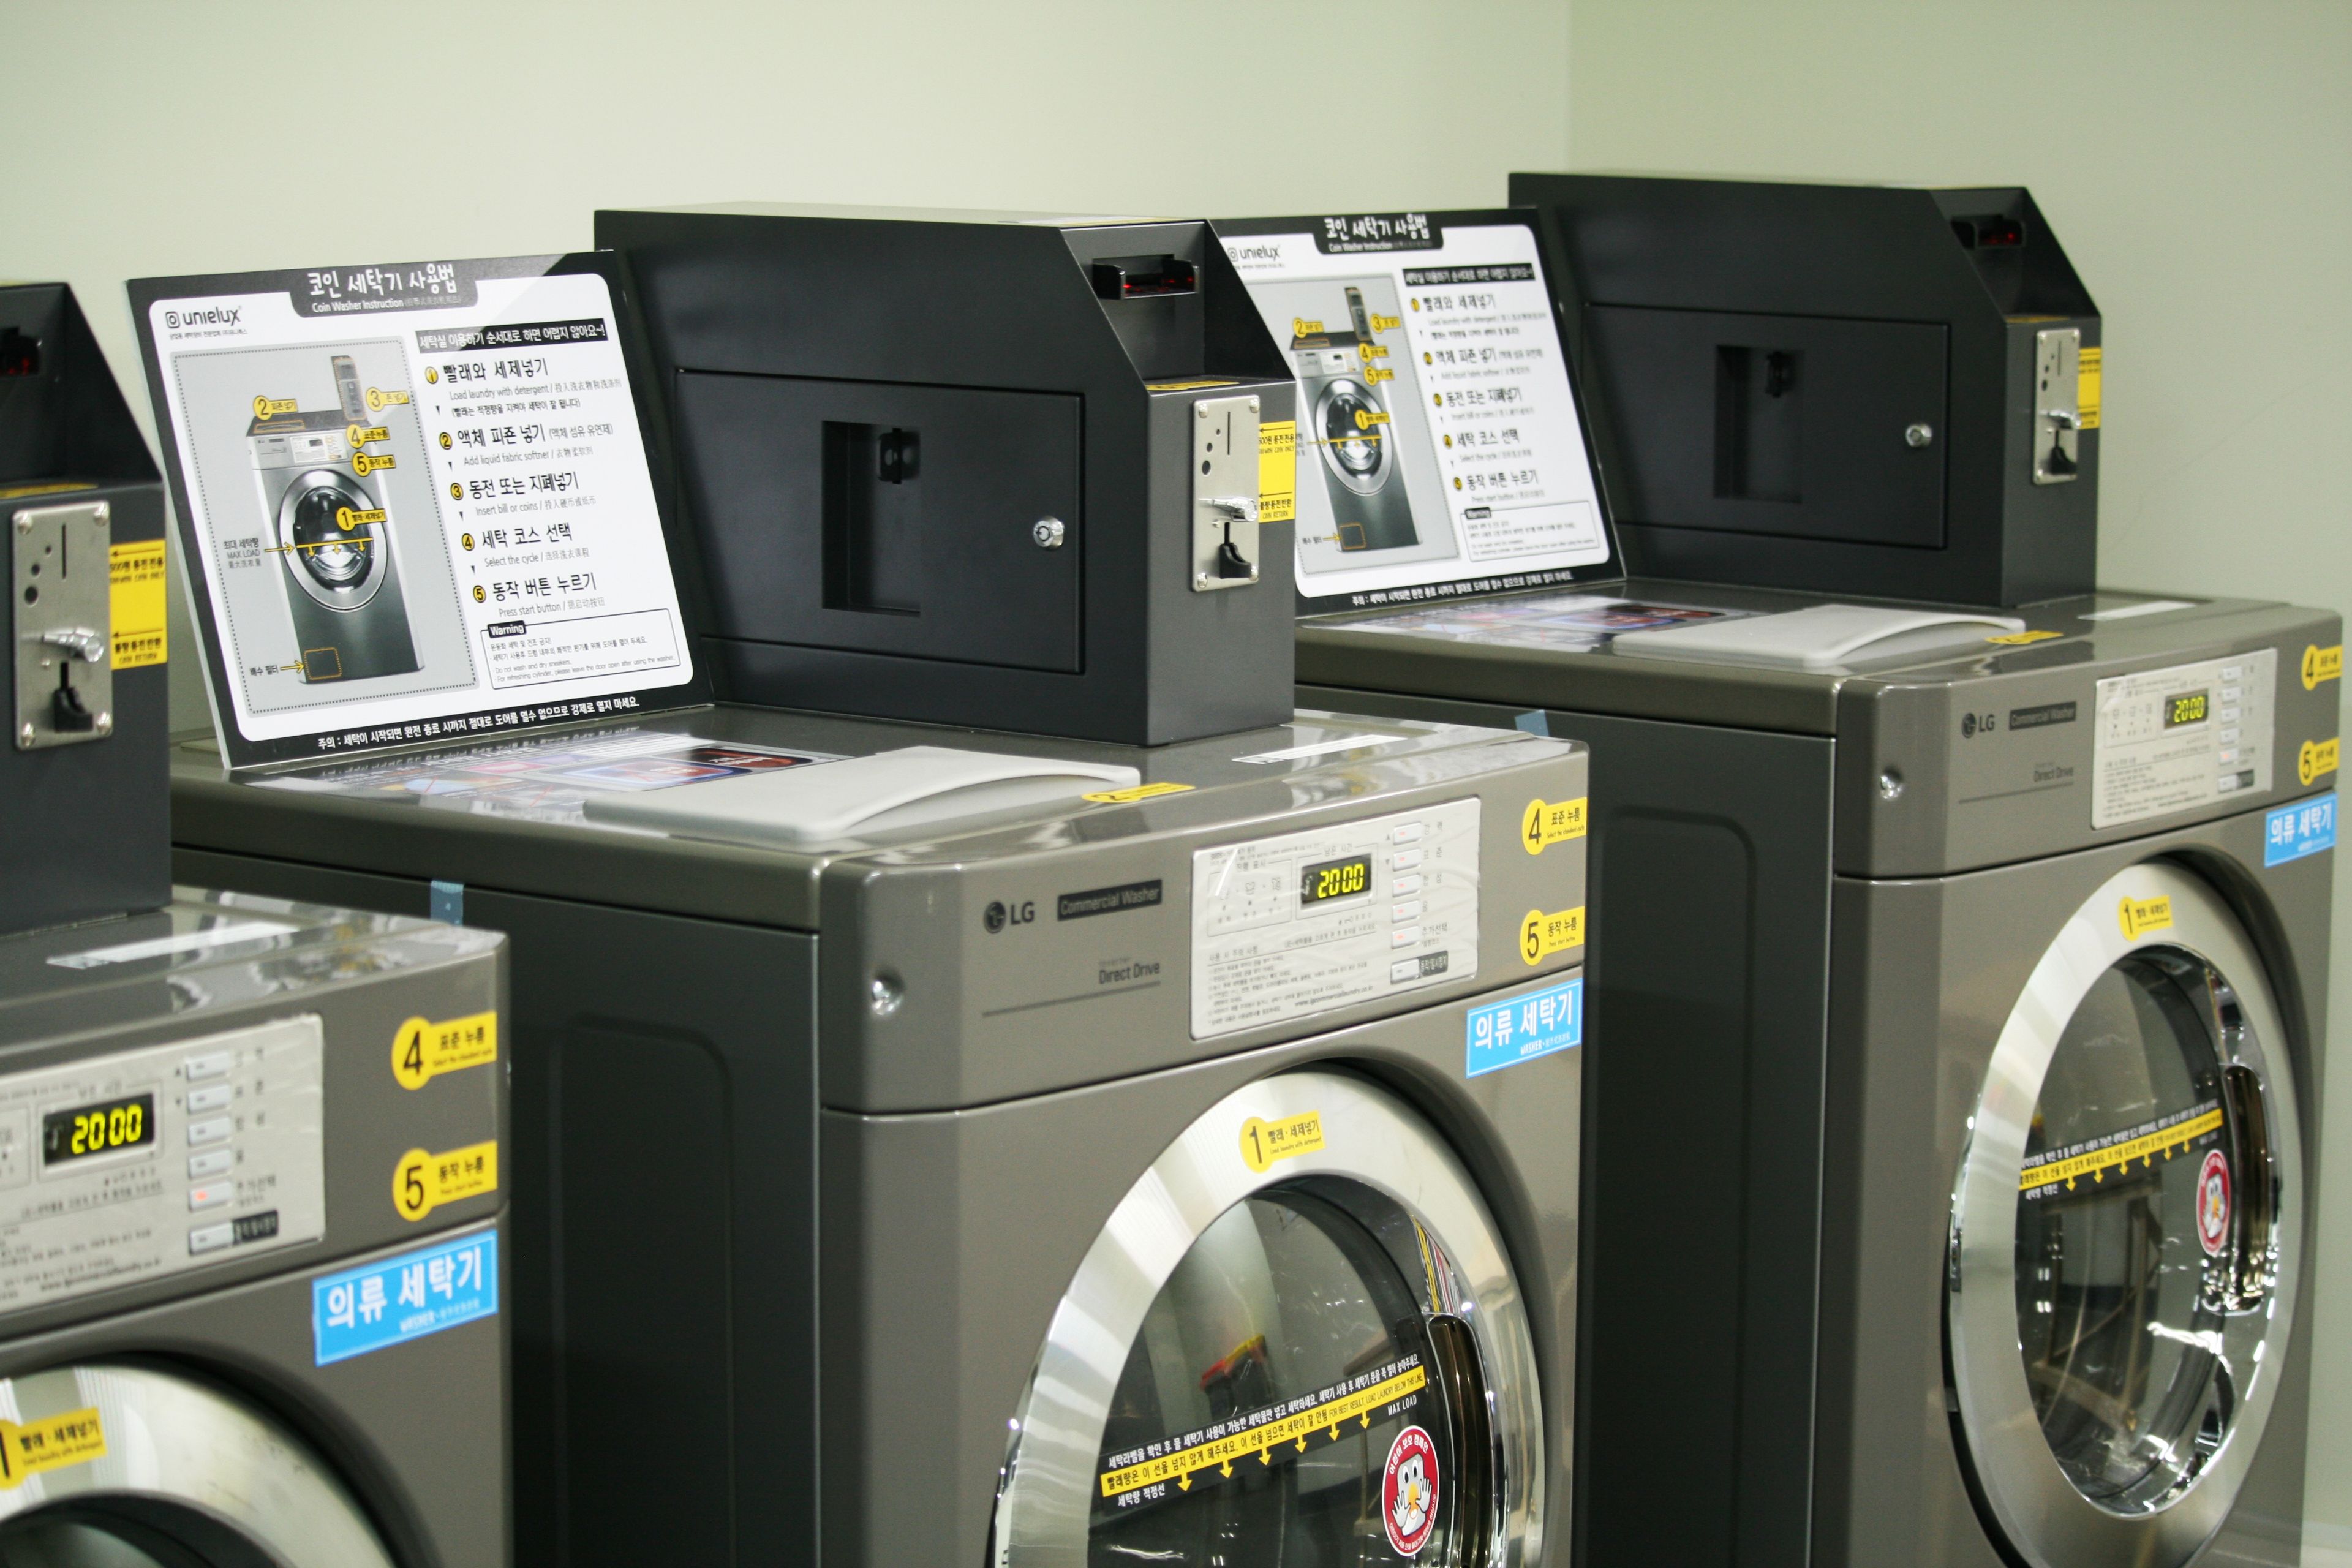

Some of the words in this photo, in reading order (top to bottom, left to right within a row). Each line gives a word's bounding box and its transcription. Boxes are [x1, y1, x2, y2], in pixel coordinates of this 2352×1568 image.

[1324, 217, 1349, 241] 코인
[1352, 216, 1392, 239] 세탁기
[1395, 213, 1430, 239] 사용법
[1240, 245, 1280, 261] unielux
[307, 270, 341, 298] 코인
[347, 268, 402, 296] 세탁기
[409, 263, 458, 295] 사용법
[183, 307, 241, 326] unielux
[312, 302, 331, 312] Coin
[331, 300, 361, 311] Washer
[363, 298, 404, 309] Instruction
[420, 335, 448, 349] 세탁실
[448, 333, 485, 347] 이용하기
[486, 330, 522, 345] 순서대로
[522, 327, 541, 341] 하면
[543, 326, 569, 340] 어렵지
[443, 363, 486, 383] 빨래와
[494, 358, 549, 379] 세제넣기
[371, 391, 380, 407] 3
[450, 390, 468, 401] Load
[469, 388, 496, 401] laundry
[497, 386, 513, 397] with
[514, 384, 549, 398] detergent
[258, 399, 269, 415] 2
[352, 428, 361, 444] 4
[458, 429, 486, 448] 액체
[490, 426, 516, 445] 피죤
[520, 423, 546, 443] 넣기
[357, 456, 368, 473] 5
[464, 456, 479, 466] Add
[481, 454, 500, 466] liquid
[502, 453, 522, 462] fabric
[524, 450, 549, 460] softner
[470, 479, 496, 499] 동전
[499, 477, 526, 496] 또는
[530, 472, 579, 492] 지폐넣기
[1511, 469, 1539, 486] 누르기
[341, 510, 349, 527] 1
[482, 529, 508, 549] 세탁
[514, 527, 541, 545] 코스
[546, 522, 573, 543] 선택
[484, 556, 507, 567] Select
[508, 554, 521, 565] the
[522, 553, 539, 565] cycle
[493, 581, 520, 601] 동작
[526, 578, 551, 597] 버튼
[557, 572, 597, 594] 누르기
[499, 608, 517, 617] Press
[519, 605, 536, 616] start
[537, 602, 560, 613] button
[490, 624, 524, 636] Warning
[2306, 654, 2314, 682] 4
[2174, 696, 2204, 723] 2000
[318, 737, 336, 750] 주의
[344, 733, 369, 746] 세탁이
[371, 728, 402, 743] 시작되면
[404, 724, 421, 738] 완전
[424, 723, 440, 736] 종료
[443, 719, 467, 734] 시까지
[469, 716, 493, 729] 절대로
[495, 712, 519, 726] 도어를
[520, 710, 537, 722] 열수
[538, 707, 570, 720] 없으므로
[571, 703, 595, 716] 강제로
[597, 700, 612, 713] 열지
[614, 696, 640, 710] 마세요.
[1979, 715, 1995, 733] LG
[2303, 751, 2310, 780] 5
[1529, 808, 1542, 844] 4
[1551, 810, 1564, 826] 표준
[1567, 807, 1581, 823] 누름
[2271, 814, 2296, 846] 의류
[2299, 802, 2331, 837] 세탁기
[1318, 863, 1365, 899] 2000
[1011, 902, 1035, 925] LG
[1061, 894, 1120, 916] Commercial
[1121, 888, 1159, 905] Washer
[2124, 904, 2133, 934] 1
[1548, 921, 1561, 937] 동작
[1564, 916, 1577, 933] 누름
[1527, 921, 1539, 959] 5
[1099, 968, 1130, 984] Direct
[1133, 962, 1160, 977] Drive
[1475, 1009, 1513, 1049] 의류
[1520, 990, 1572, 1036] 세탁기
[404, 1030, 423, 1075] 4
[1520, 1039, 1543, 1056] WASHER
[72, 1104, 143, 1155] 2000
[1268, 1128, 1284, 1144] 빨래
[1290, 1119, 1319, 1138] 세제넣기
[1250, 1125, 1262, 1164] 1
[1280, 1144, 1295, 1153] laundry
[406, 1165, 424, 1210] 5
[326, 1275, 387, 1329] 의류
[398, 1245, 481, 1308] 세탁기
[1387, 1404, 1401, 1416] MAX
[1402, 1395, 1417, 1411] LOAD
[1109, 1447, 1145, 1469] 세탁라벨을
[1147, 1442, 1162, 1458] 확인
[1164, 1440, 1172, 1453] 후
[1174, 1437, 1182, 1450] 물
[1183, 1431, 1205, 1448] 세탁기
[1206, 1423, 1226, 1440] 사용이
[1227, 1417, 1247, 1433] 가능한
[1249, 1407, 1273, 1427] 세탁물만
[1274, 1404, 1287, 1419] 넣고
[1319, 1387, 1336, 1403] 세탁기
[1336, 1382, 1348, 1396] 사용
[1348, 1380, 1354, 1393] 후
[1355, 1374, 1370, 1390] 세탁기
[1370, 1369, 1381, 1384] 문을
[1107, 1469, 1139, 1490] 빨래량은
[1142, 1466, 1150, 1479] 이
[1154, 1461, 1169, 1476] 선을
[1172, 1457, 1186, 1471] 넘지
[1189, 1451, 1204, 1466] 않게
[1207, 1441, 1238, 1460] 해주세요.
[1241, 1436, 1248, 1449] 이
[1250, 1431, 1263, 1446] 선을
[1265, 1424, 1284, 1441] 넘으면
[1287, 1417, 1305, 1433] 세탁이
[1308, 1414, 1314, 1427] 잘
[1316, 1409, 1328, 1423] 안됨
[1329, 1408, 1338, 1418] FOR
[1338, 1404, 1349, 1415] BEST
[1366, 1393, 1377, 1404] LOAD
[1377, 1387, 1393, 1399] LAUNDRY
[1393, 1381, 1406, 1394] BELOW
[1406, 1378, 1415, 1387] THIS
[1389, 1445, 1403, 1476] 어린이
[1402, 1434, 1414, 1450] 보호
[1414, 1434, 1430, 1455] 캠페인
[1118, 1491, 1140, 1507] 세탁량
[1143, 1483, 1166, 1501] 적정선
